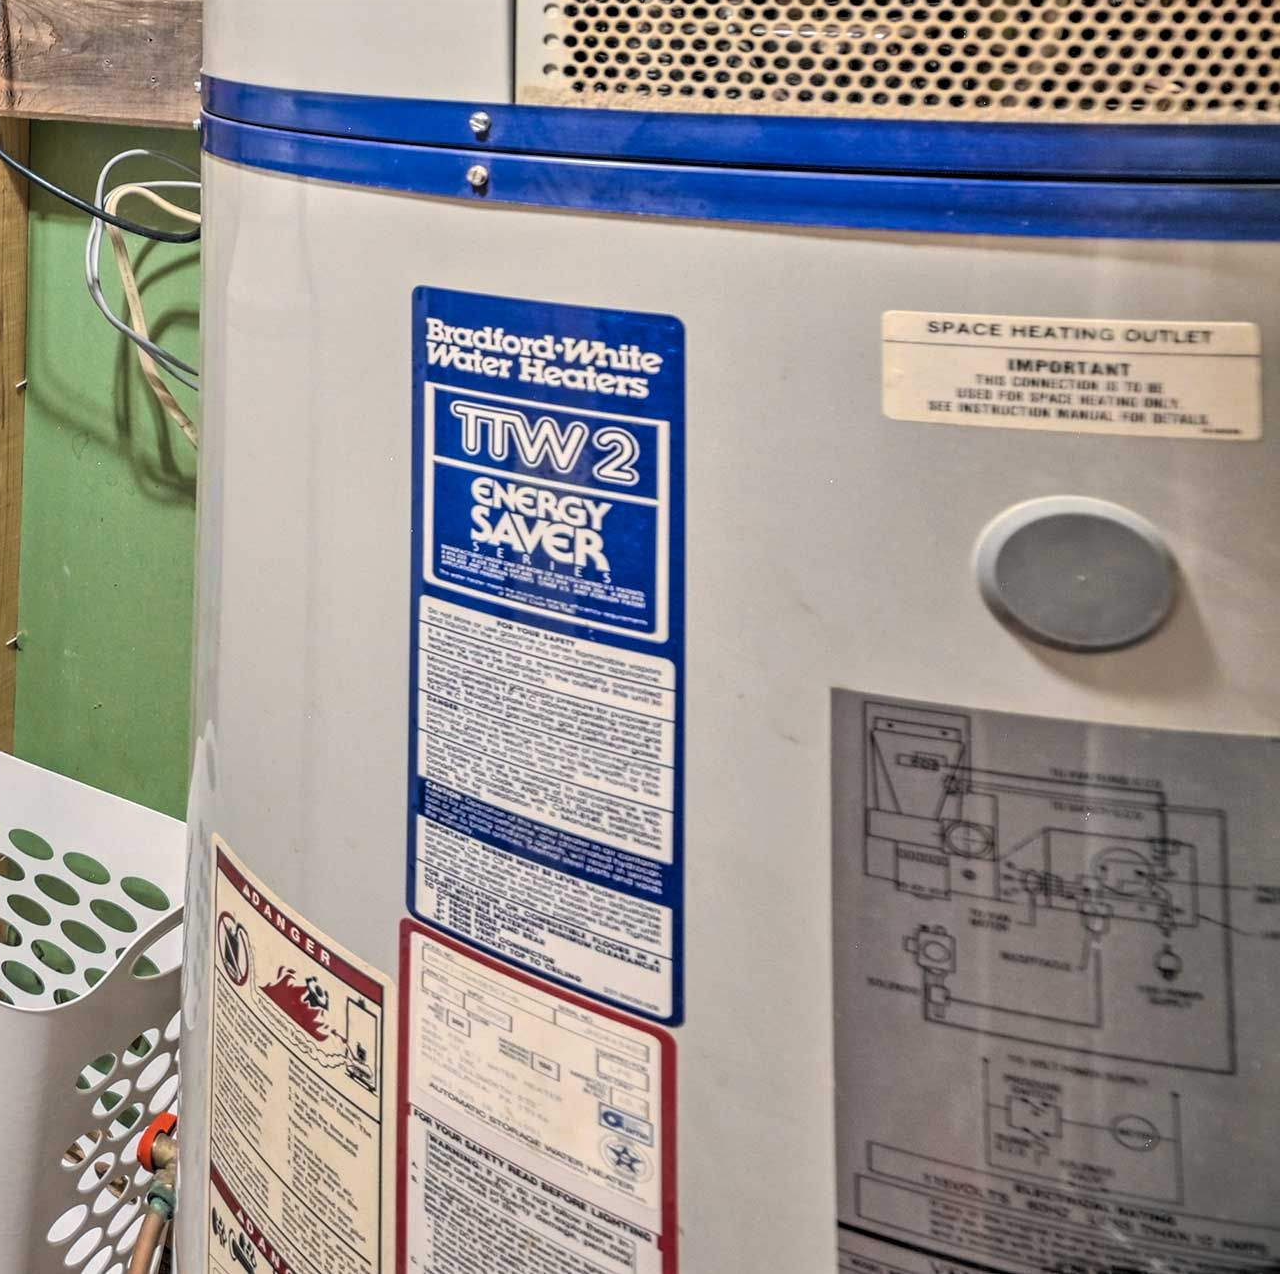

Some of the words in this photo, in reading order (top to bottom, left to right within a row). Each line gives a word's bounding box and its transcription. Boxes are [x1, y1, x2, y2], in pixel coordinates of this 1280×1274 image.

[927, 321, 1002, 337] SPACE
[1010, 325, 1115, 341] HEATING
[1125, 328, 1212, 344] OUTLET
[426, 341, 513, 379] Water
[519, 357, 650, 399] Heaters
[975, 374, 1006, 386] THIS
[1012, 376, 1099, 391] CONNECTION
[1127, 381, 1142, 393] TO
[1007, 358, 1131, 376] IMPORTANT
[928, 400, 952, 412] SEE
[958, 402, 1050, 418] INSTRUCTION
[1056, 408, 1113, 422] MANUAL
[956, 388, 992, 399] USED
[998, 390, 1024, 402] FOR
[1030, 391, 1072, 405] SPACE
[1080, 394, 1137, 408] HEATING
[451, 400, 588, 474] TTW
[592, 427, 640, 487] 2
[470, 476, 613, 531] ENERGY
[470, 505, 612, 572] SAVER
[251, 889, 331, 966] DANGER
